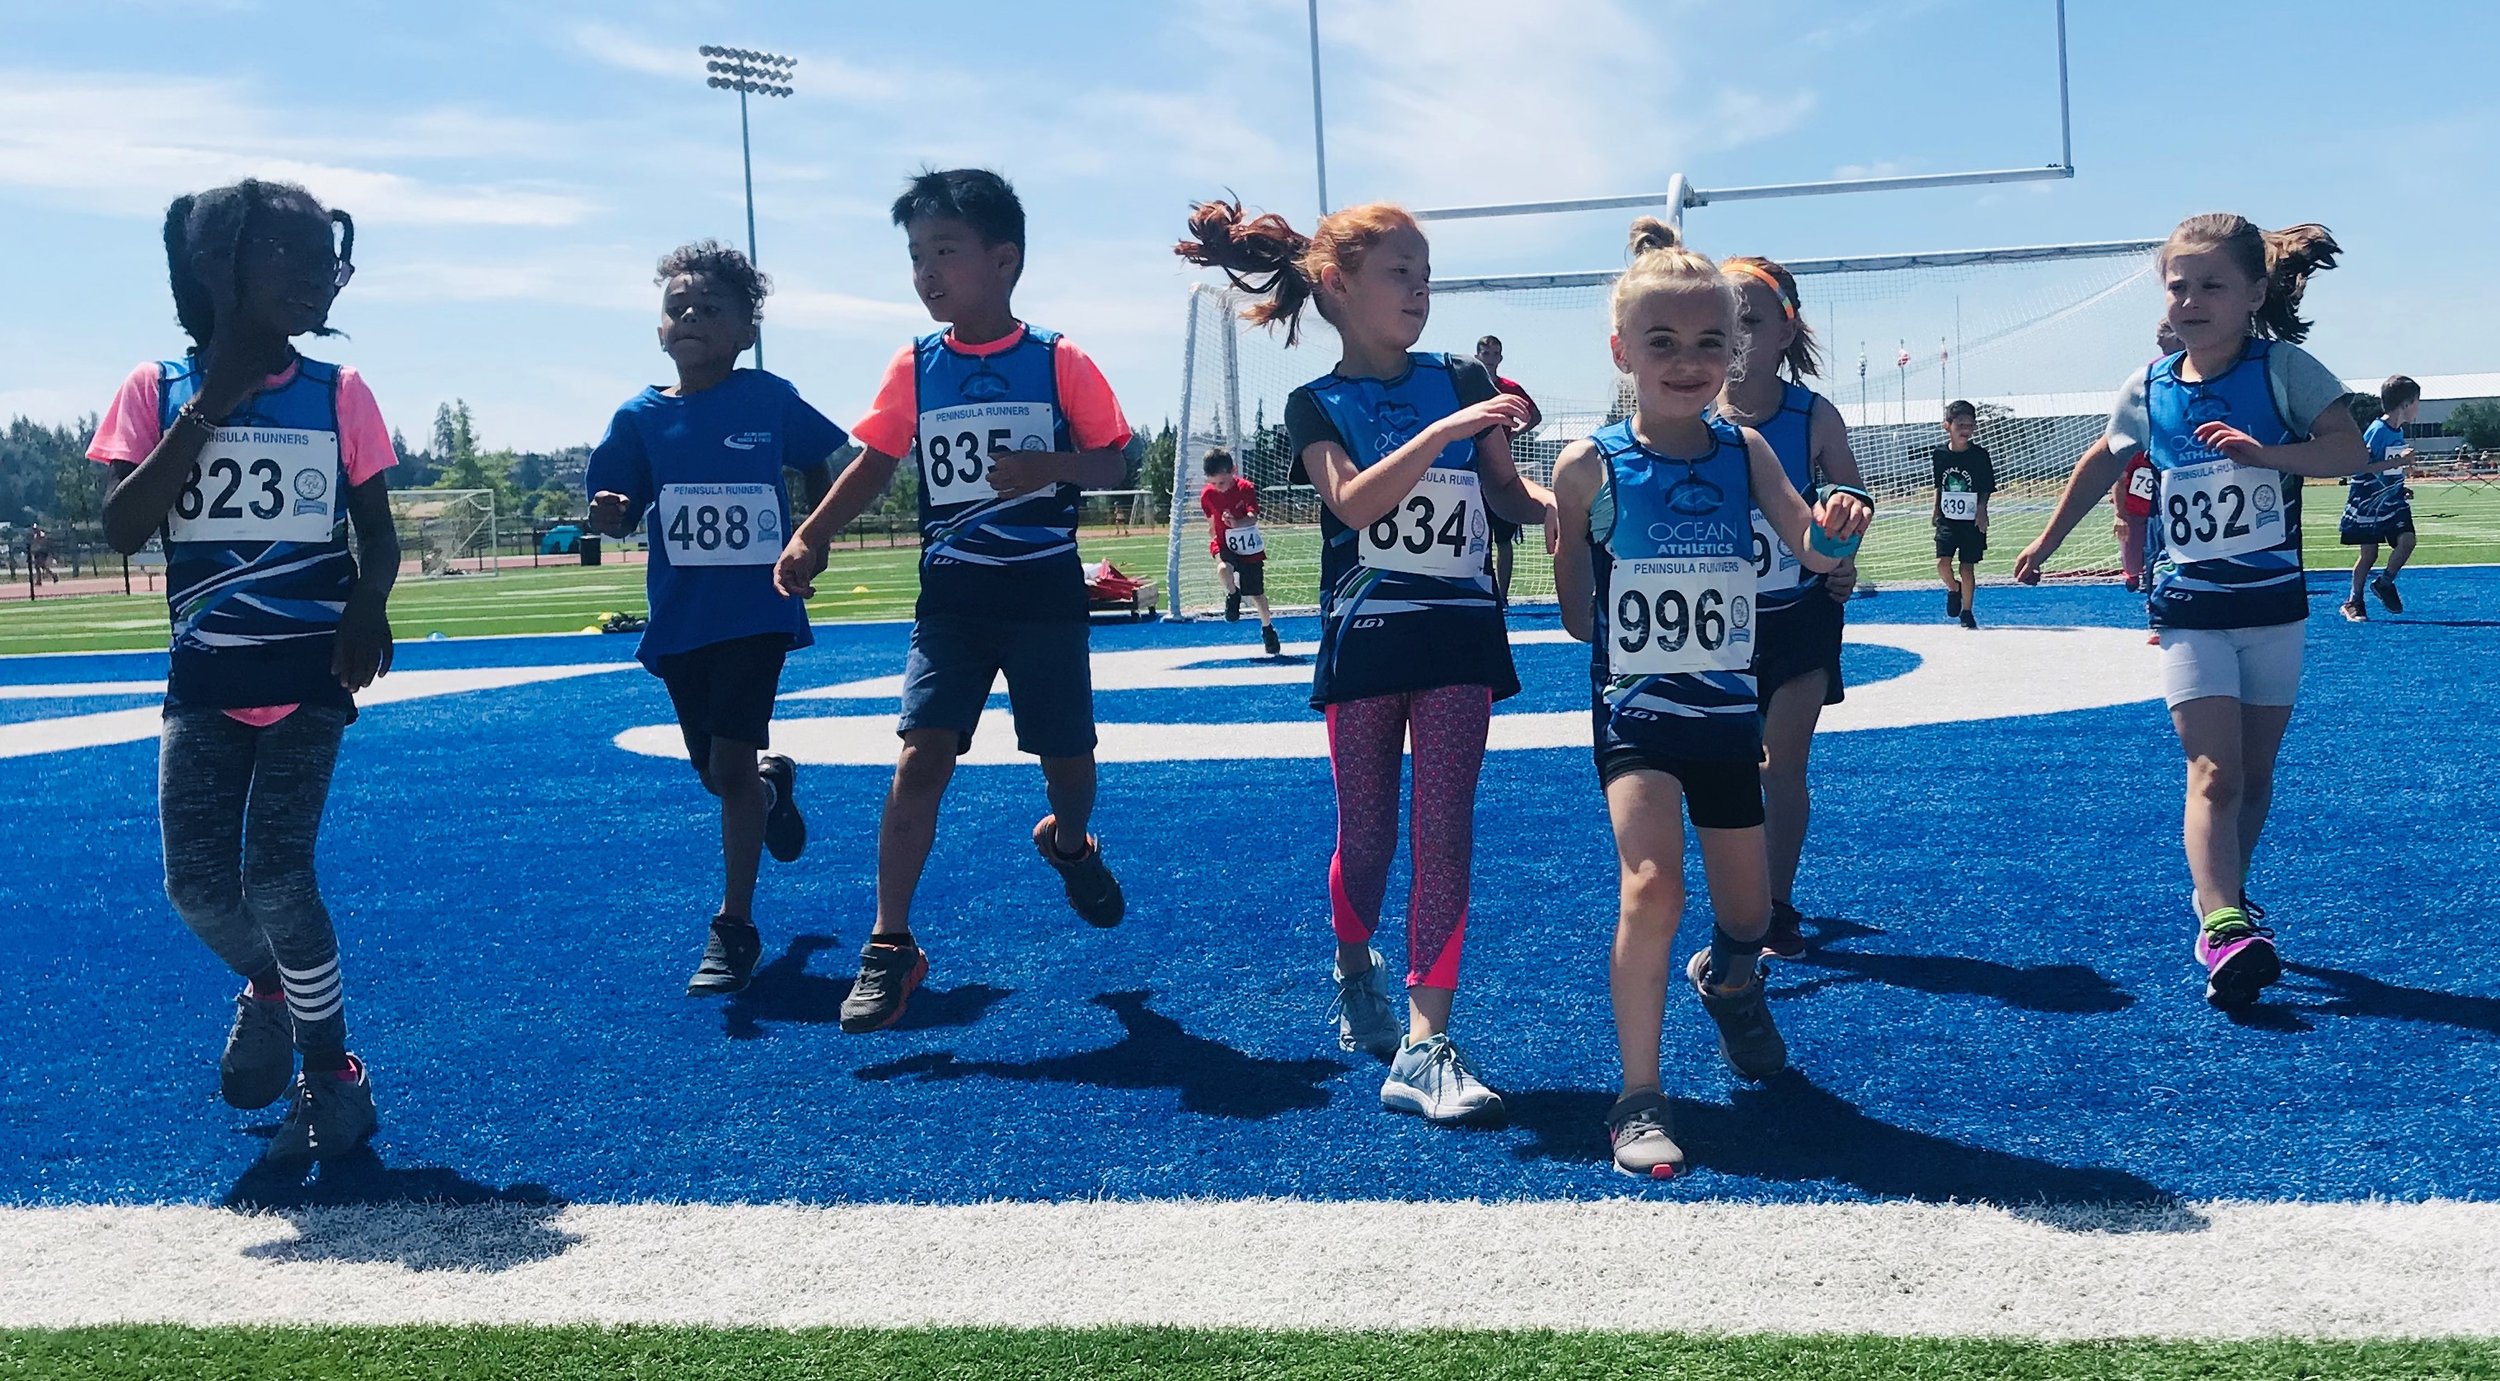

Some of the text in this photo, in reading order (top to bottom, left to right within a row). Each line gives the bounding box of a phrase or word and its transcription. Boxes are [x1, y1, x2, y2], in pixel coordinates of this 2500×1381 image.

[936, 406, 1030, 422] PENINSULA RUNNERS
[206, 431, 309, 445] INSULA RUNNERS
[1961, 470, 1973, 487] CITY
[2173, 467, 2215, 481] PENINSULA
[175, 457, 284, 520] 823
[674, 486, 763, 495] PENINSULA RUNNERS
[1943, 499, 1966, 515] 839
[2168, 485, 2250, 546] 832
[668, 505, 750, 550] 488
[1368, 496, 1466, 557] 834
[1647, 521, 1738, 541] OCEAN
[1228, 533, 1256, 551] 814
[1657, 543, 1734, 555] ATHLETICS
[1634, 561, 1739, 575] PENINSULA RUNNERS
[1618, 588, 1725, 653] 996
